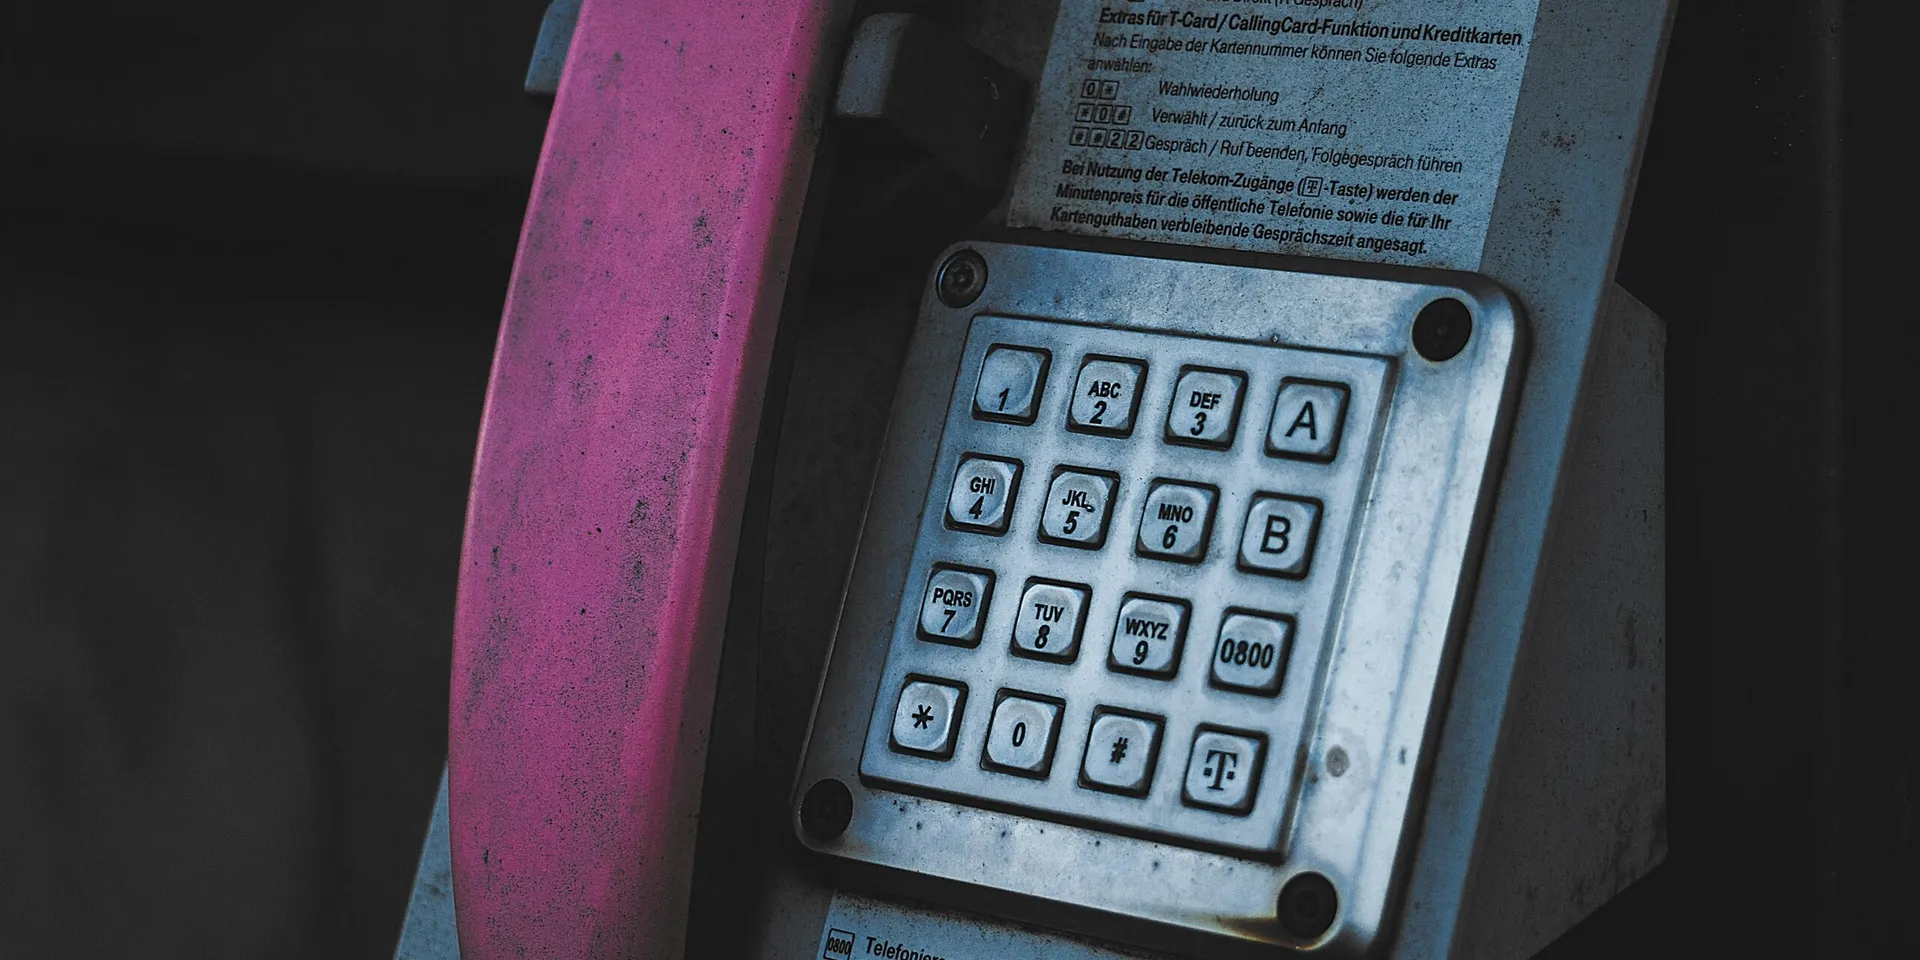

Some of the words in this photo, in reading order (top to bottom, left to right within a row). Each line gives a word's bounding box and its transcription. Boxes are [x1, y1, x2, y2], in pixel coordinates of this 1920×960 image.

[1100, 8, 1144, 25] Extras
[1146, 10, 1168, 26] für
[1169, 11, 1219, 29] T-Card
[1228, 14, 1389, 39] CallingCard-Funktion
[1391, 24, 1421, 41] und
[1423, 24, 1521, 46] Kreditkarten
[1093, 33, 1125, 48] Nach
[1130, 34, 1183, 52] Eingabe
[1185, 37, 1207, 52] der
[1210, 39, 1308, 58] Kartennummer
[1311, 45, 1361, 62] können
[1365, 47, 1387, 64] Sie
[1389, 49, 1450, 68] folgende
[1454, 52, 1497, 70] Extras
[1088, 58, 1152, 73] anwählen:
[1159, 81, 1279, 105] Wahlwiederholung
[1152, 107, 1208, 126] Verwählt
[1208, 111, 1218, 129] /
[1220, 113, 1264, 130] zurück
[1266, 119, 1295, 132] zum
[1298, 118, 1347, 138] Anfang
[1145, 135, 1207, 156] Gespräch
[1208, 140, 1219, 157] /
[1220, 139, 1246, 156] Ruf
[1247, 141, 1307, 164] beenden,
[1312, 147, 1413, 170] Folgegespräch
[1417, 156, 1462, 174] führen
[1062, 159, 1084, 176] Bei
[1086, 161, 1141, 183] Nutzung
[1145, 166, 1168, 182] der
[1172, 167, 1294, 193] Telekom-Zugänge
[1376, 186, 1429, 204] werden
[1433, 190, 1459, 206] der
[1056, 183, 1143, 205] Minutenpreis
[1146, 192, 1165, 207] für
[1168, 193, 1189, 208] die
[1192, 194, 1265, 214] öffentliche
[1270, 200, 1333, 220] Telefonie
[1336, 209, 1378, 224] sowie
[1381, 211, 1404, 226] die
[1407, 212, 1428, 229] für
[1430, 214, 1452, 230] Ihr
[1051, 206, 1158, 230] Kartenguthaben
[1161, 219, 1249, 238] verbleibende
[1253, 223, 1354, 248] Gesprächszeit
[1357, 236, 1427, 256] angesagt.
[998, 388, 1010, 411] 1
[1088, 381, 1121, 399] ABC
[1190, 391, 1221, 410] DEF
[1090, 401, 1107, 424] 2
[1191, 412, 1207, 436] 3
[1285, 401, 1317, 440] A
[970, 477, 996, 495] GHI
[969, 496, 985, 519] 4
[1062, 490, 1088, 508] JKL
[1063, 511, 1080, 534] 5
[1158, 503, 1193, 523] MNO
[1163, 525, 1178, 549] 6
[1260, 515, 1291, 554] B
[932, 588, 973, 607] PQRS
[941, 610, 957, 633] 7
[1035, 604, 1064, 622] TUV
[1035, 625, 1050, 649] 8
[1126, 618, 1169, 640] WXYZ
[1133, 641, 1149, 665] 9
[1220, 638, 1274, 669] 0800
[1012, 722, 1026, 747] 0
[1110, 737, 1128, 764] #
[827, 937, 852, 955] 0800
